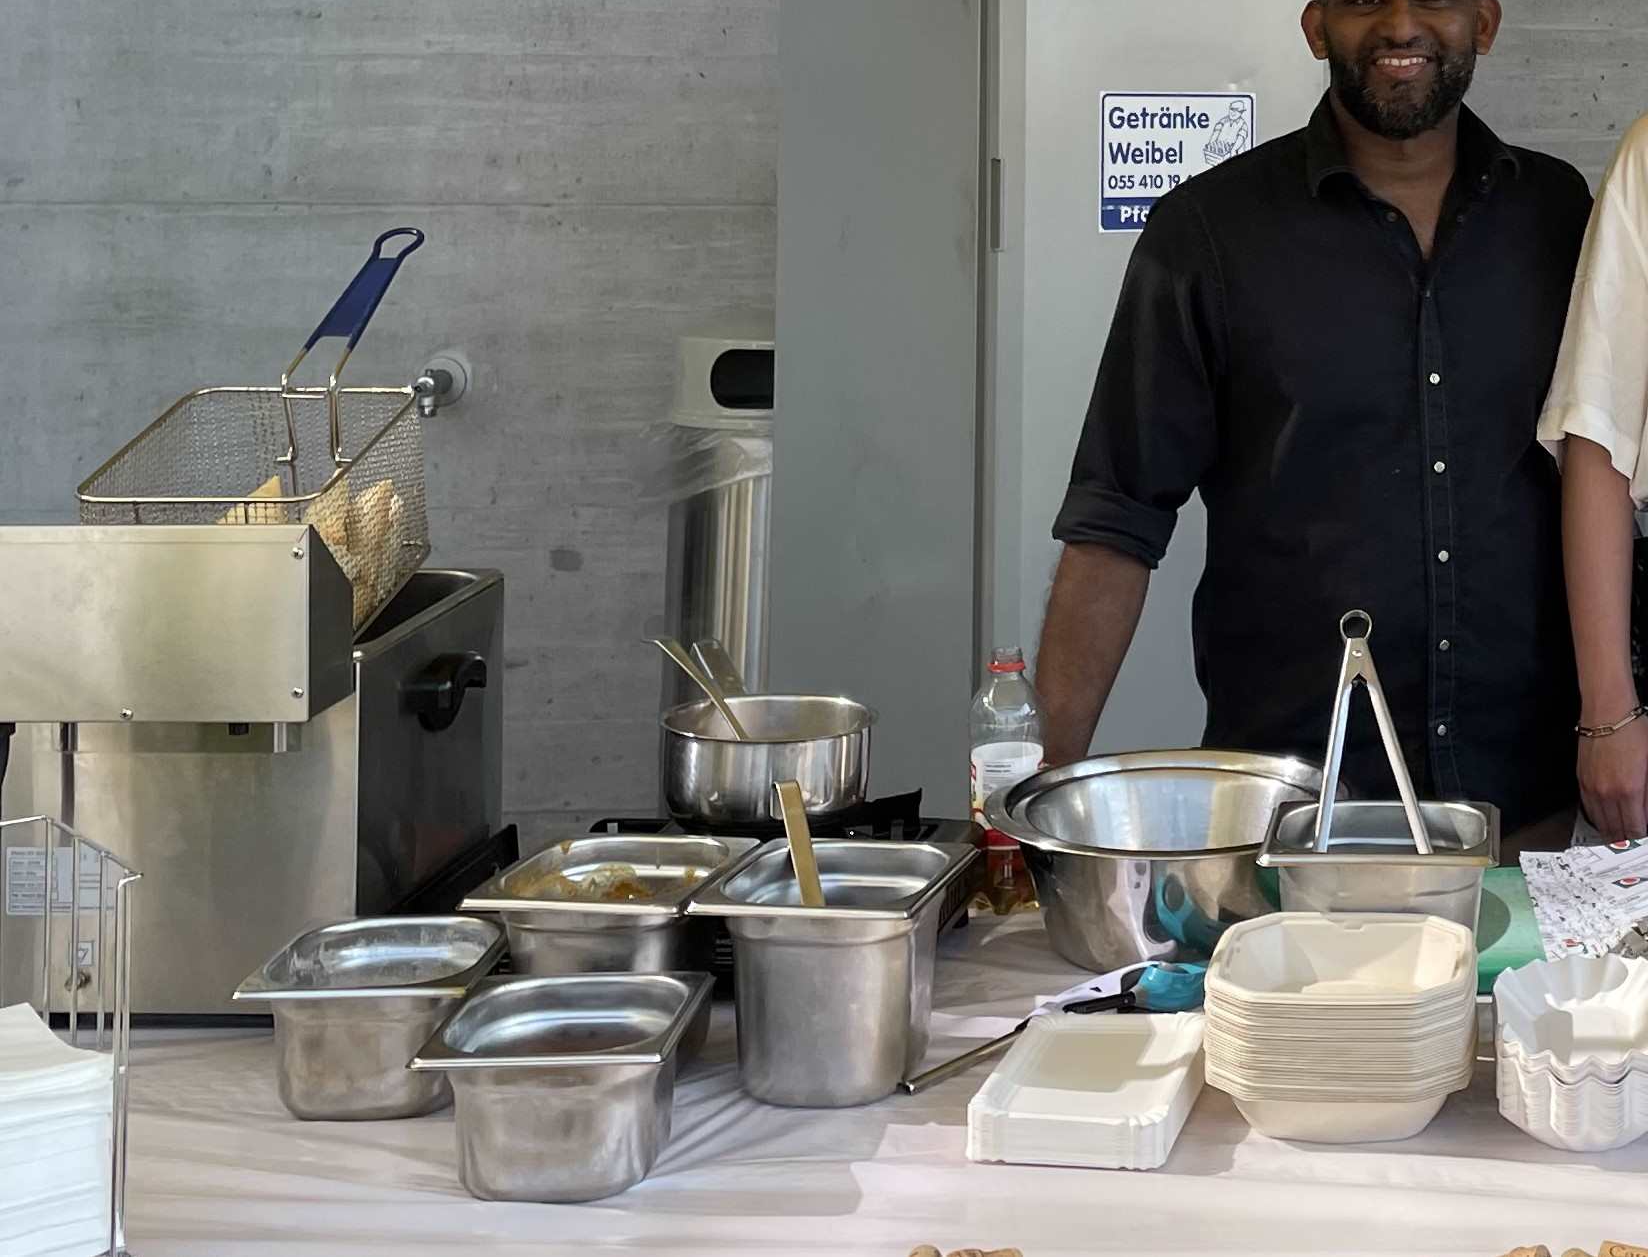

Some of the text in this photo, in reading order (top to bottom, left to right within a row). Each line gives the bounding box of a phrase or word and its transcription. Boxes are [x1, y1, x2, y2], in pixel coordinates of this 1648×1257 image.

[1108, 106, 1210, 129] Getränke
[1108, 140, 1183, 164] Weibel
[1108, 174, 1135, 189] 055
[1139, 174, 1163, 189] 410
